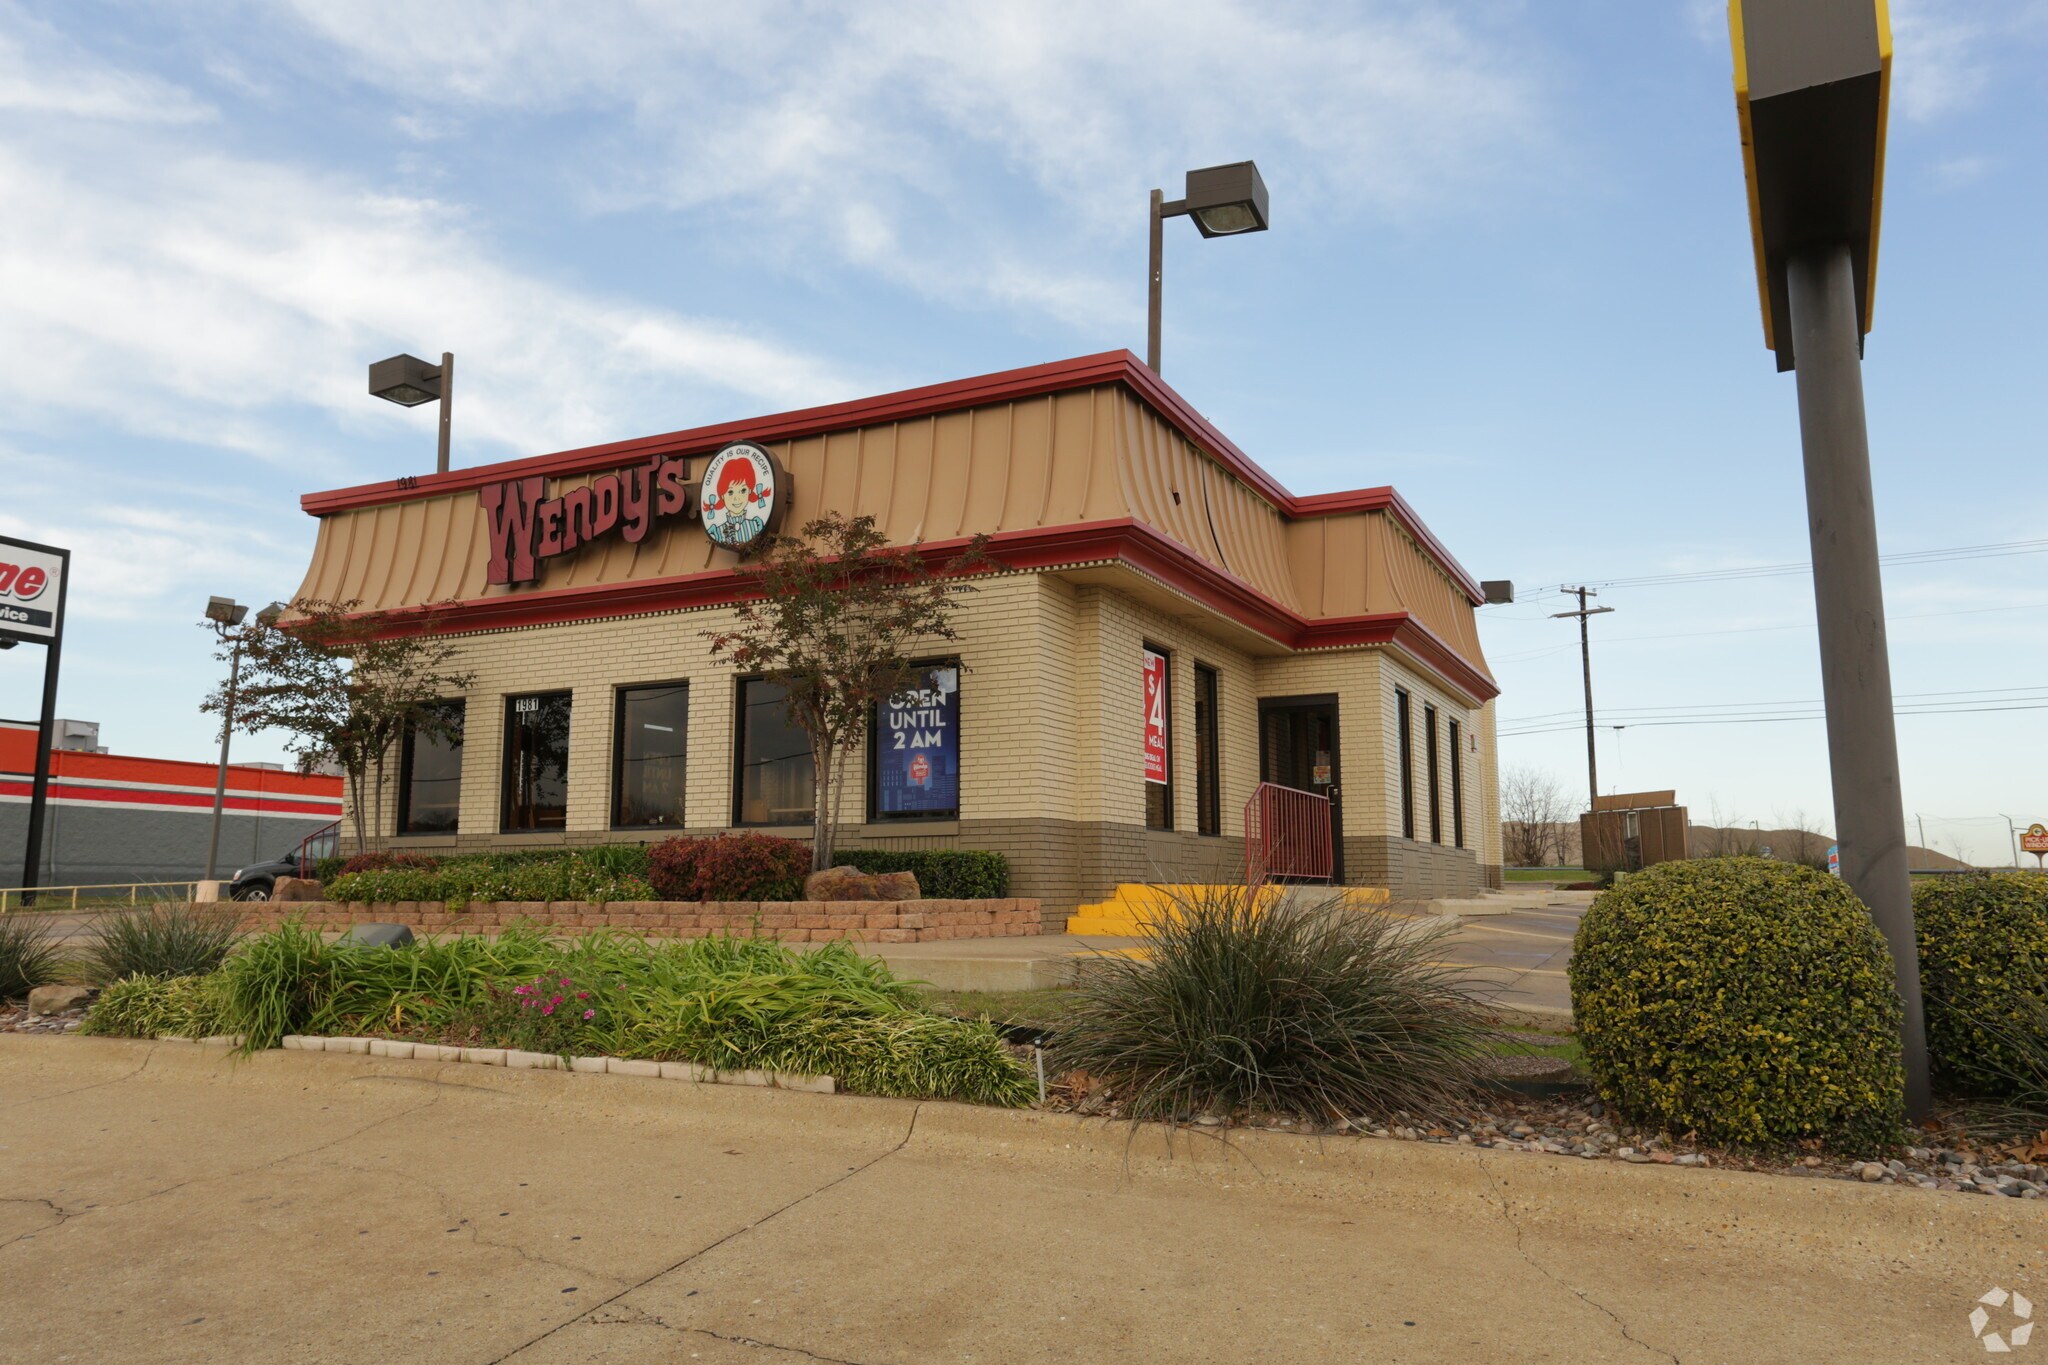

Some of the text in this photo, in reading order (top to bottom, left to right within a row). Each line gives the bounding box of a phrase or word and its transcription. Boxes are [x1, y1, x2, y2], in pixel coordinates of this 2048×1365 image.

[705, 448, 770, 486] QUALITY IS OUR RECIPE
[517, 698, 537, 711] 1981
[889, 709, 946, 730] UNTIL
[893, 729, 942, 749] 2 AM
[1148, 734, 1164, 749] MEAL
